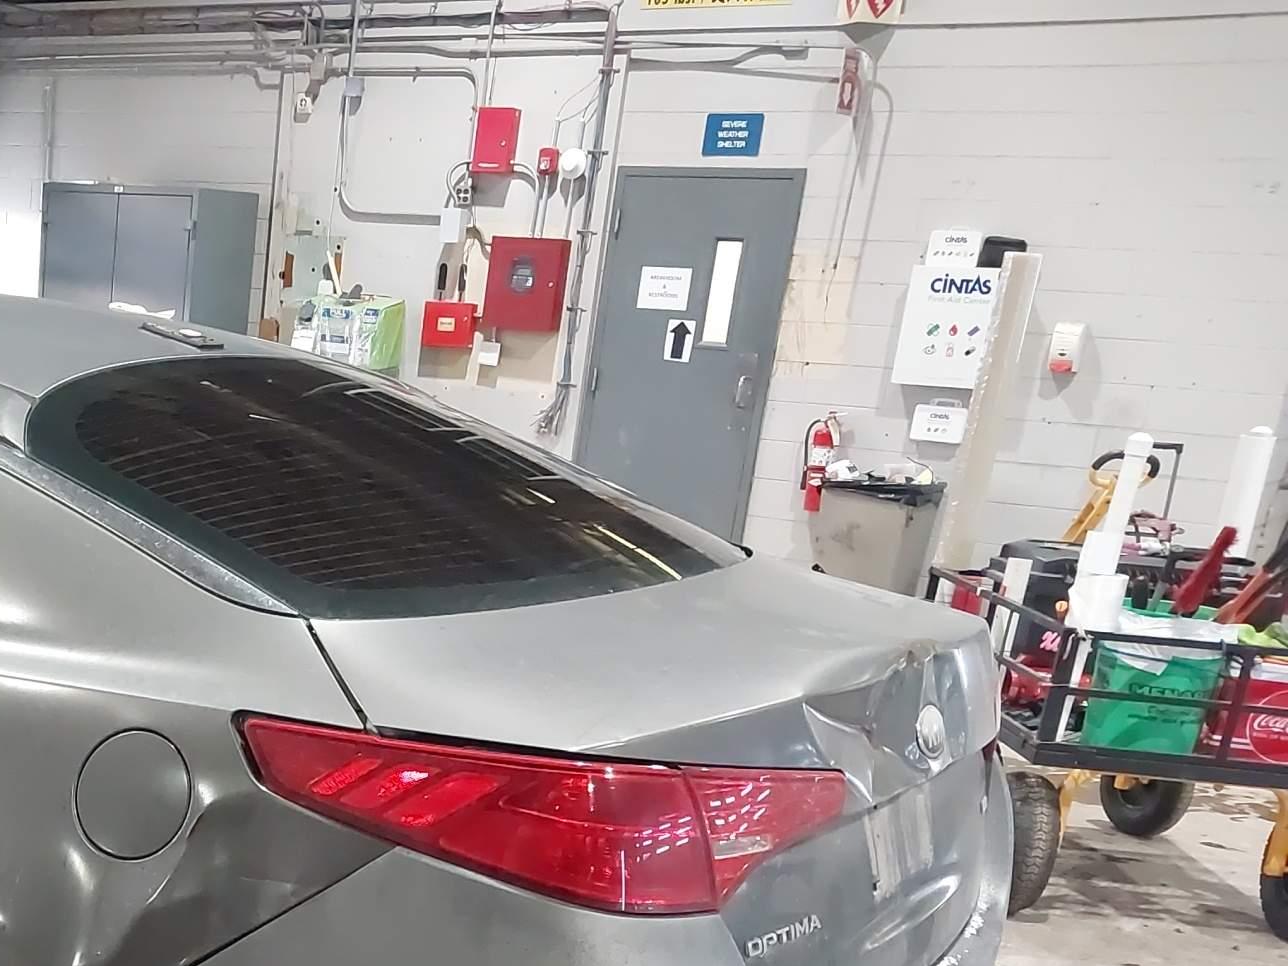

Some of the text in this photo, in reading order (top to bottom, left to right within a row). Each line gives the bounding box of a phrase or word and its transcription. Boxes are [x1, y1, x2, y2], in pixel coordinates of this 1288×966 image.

[721, 120, 748, 128] SEVERE
[717, 130, 749, 138] WEATHER
[716, 140, 747, 148] SHELTER
[930, 273, 992, 295] CINTAS
[745, 914, 822, 957] OPTIMA
